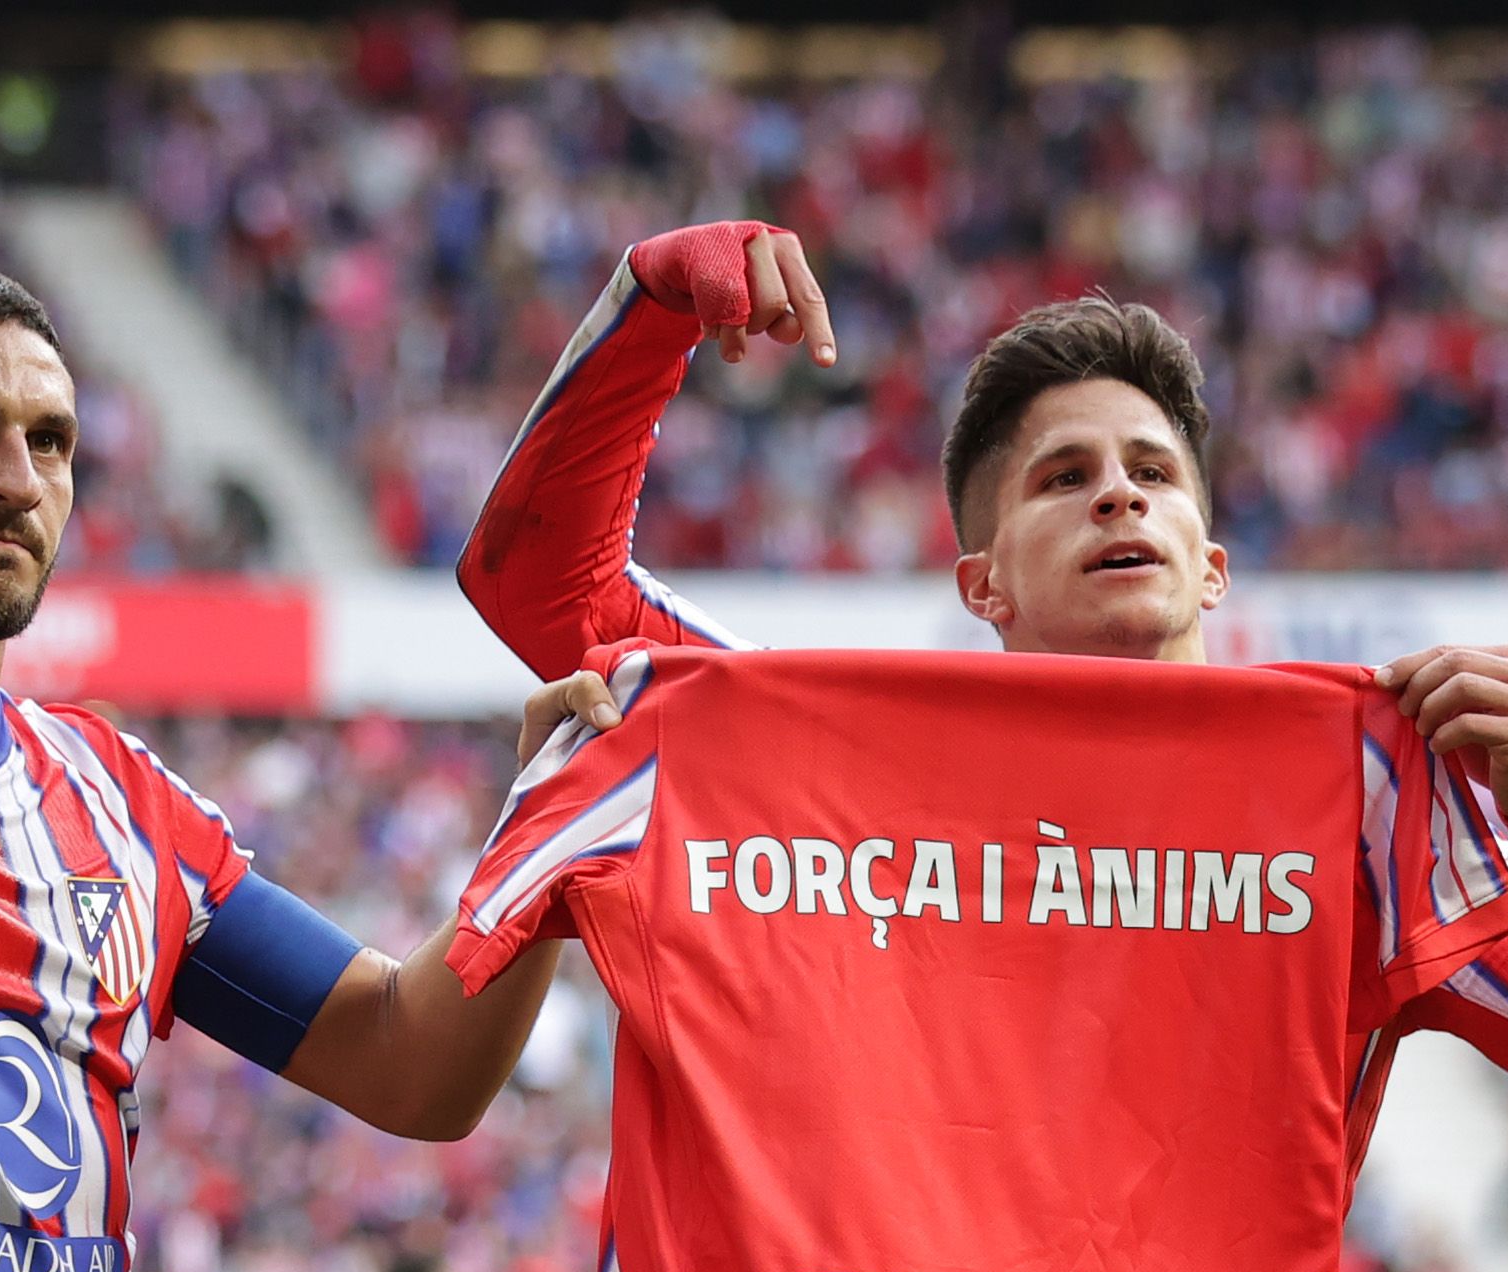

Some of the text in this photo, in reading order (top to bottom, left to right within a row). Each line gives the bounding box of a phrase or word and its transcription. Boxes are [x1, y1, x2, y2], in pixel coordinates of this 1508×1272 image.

[685, 819, 1316, 950] FORÇA I ÀNIMS
